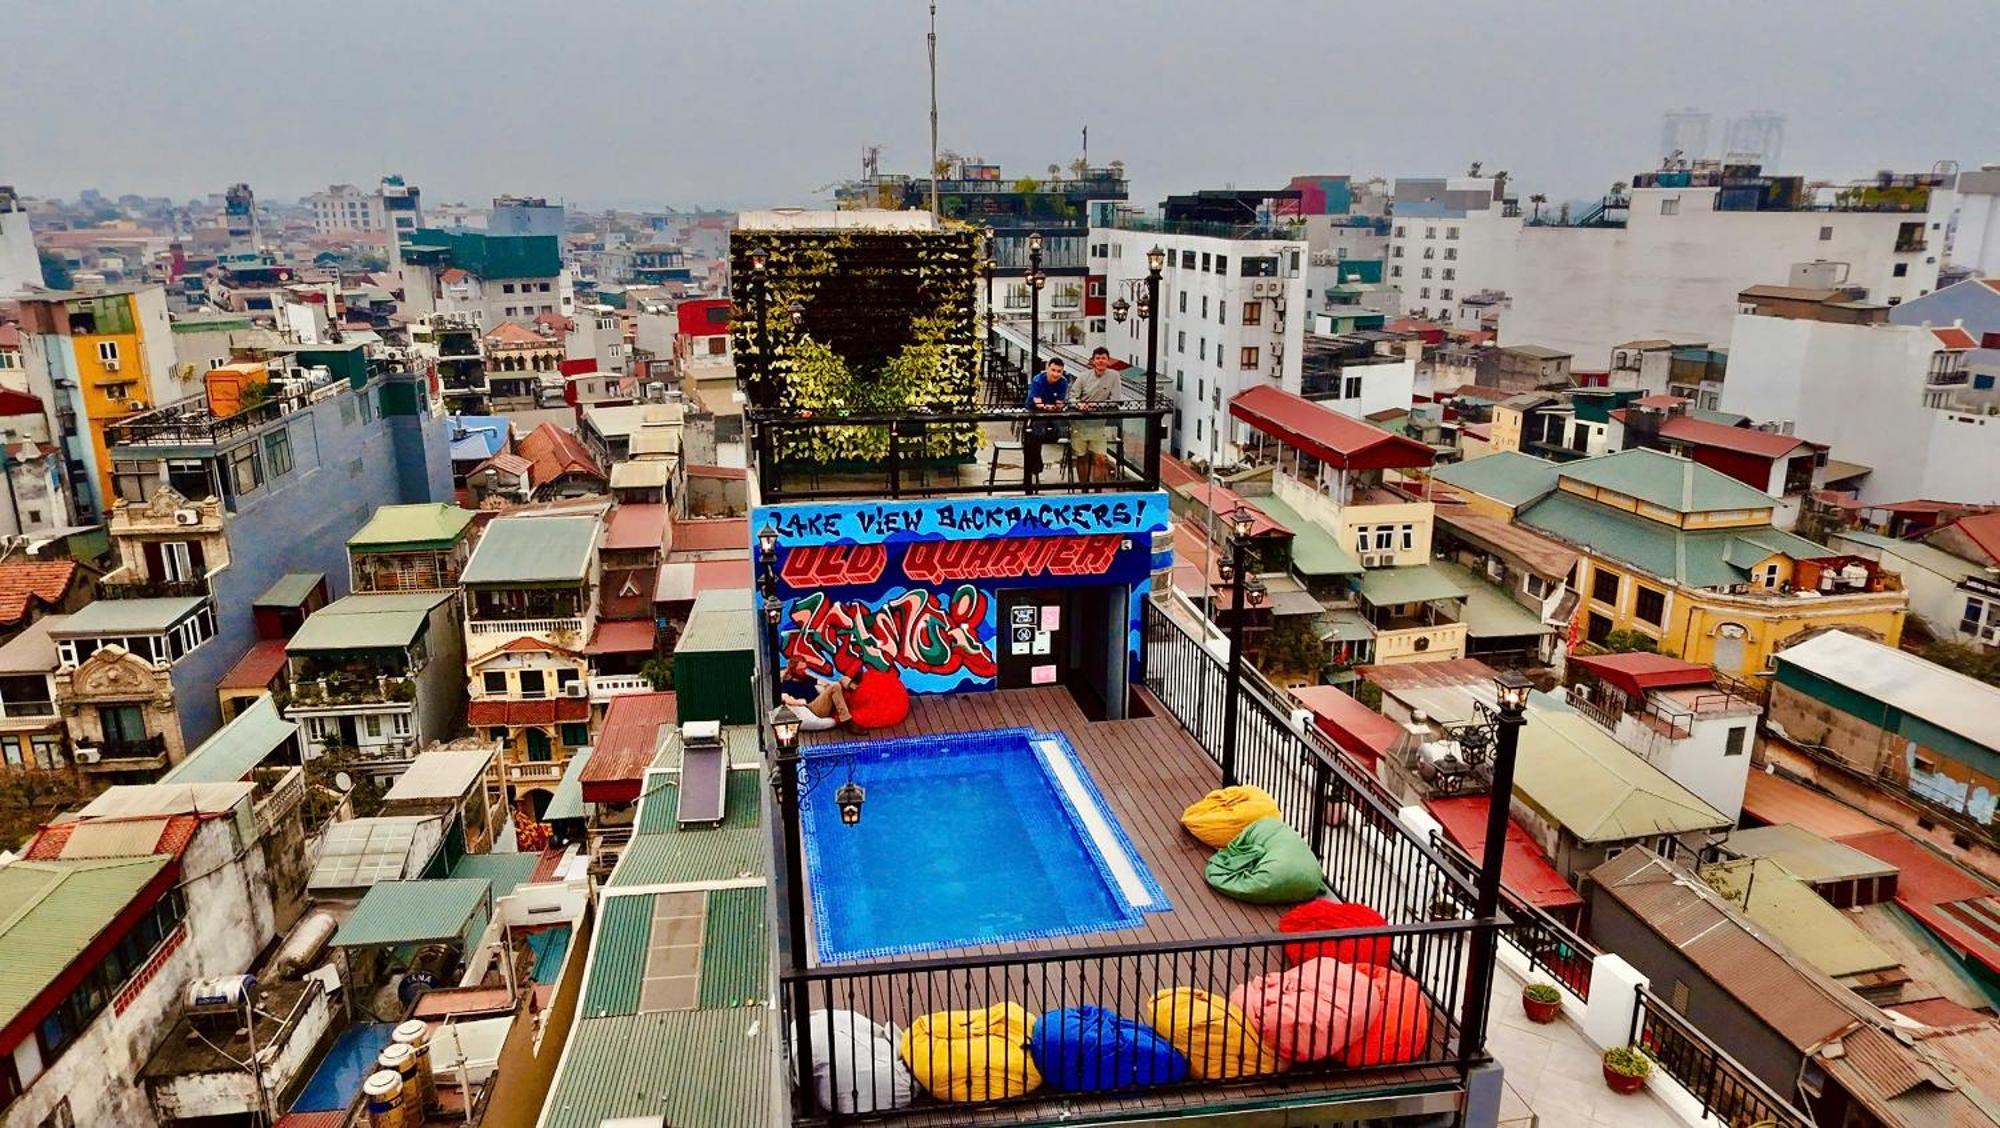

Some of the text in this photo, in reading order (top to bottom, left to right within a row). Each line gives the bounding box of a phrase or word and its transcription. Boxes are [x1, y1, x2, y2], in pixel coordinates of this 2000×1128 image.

[769, 511, 842, 537] LAKE
[937, 500, 1146, 531] BACKPACKERS!
[780, 533, 1124, 588] OLD QUARTER
